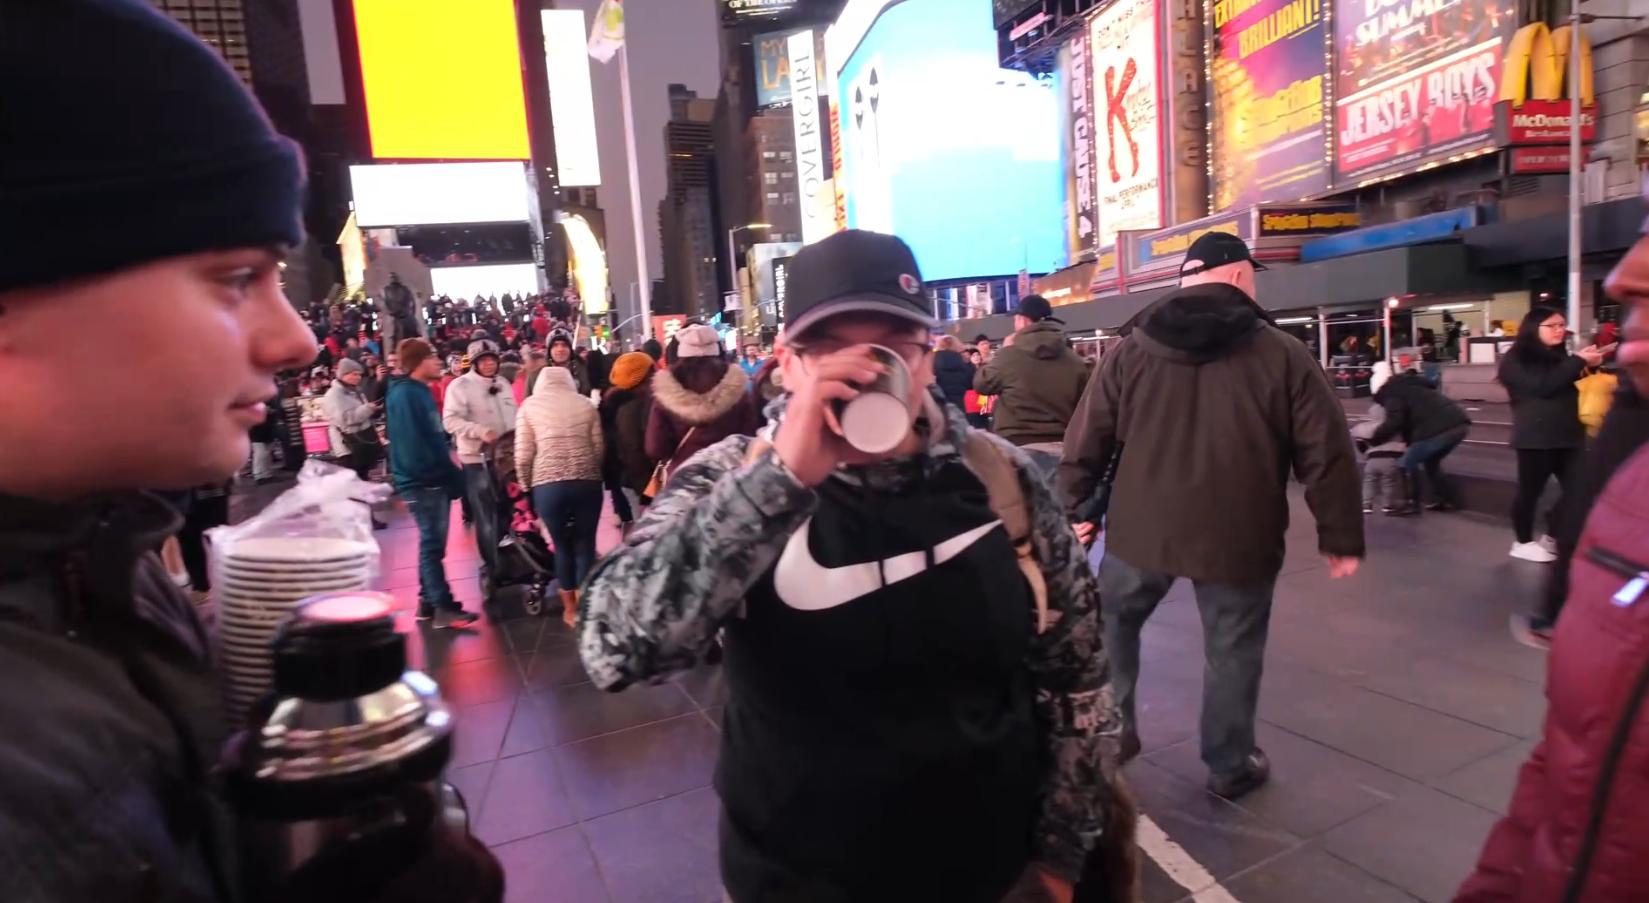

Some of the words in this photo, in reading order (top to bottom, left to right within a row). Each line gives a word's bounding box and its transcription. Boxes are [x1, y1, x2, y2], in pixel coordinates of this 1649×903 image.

[761, 38, 786, 58] MY
[1239, 0, 1320, 59] BRILLIANT!
[1070, 36, 1087, 113] JUST
[1341, 78, 1423, 147] JERSEY
[1427, 52, 1496, 110] BOYS
[795, 48, 818, 219] COVERGIRL
[1074, 117, 1091, 213] CAUSE
[1078, 215, 1092, 239] 4
